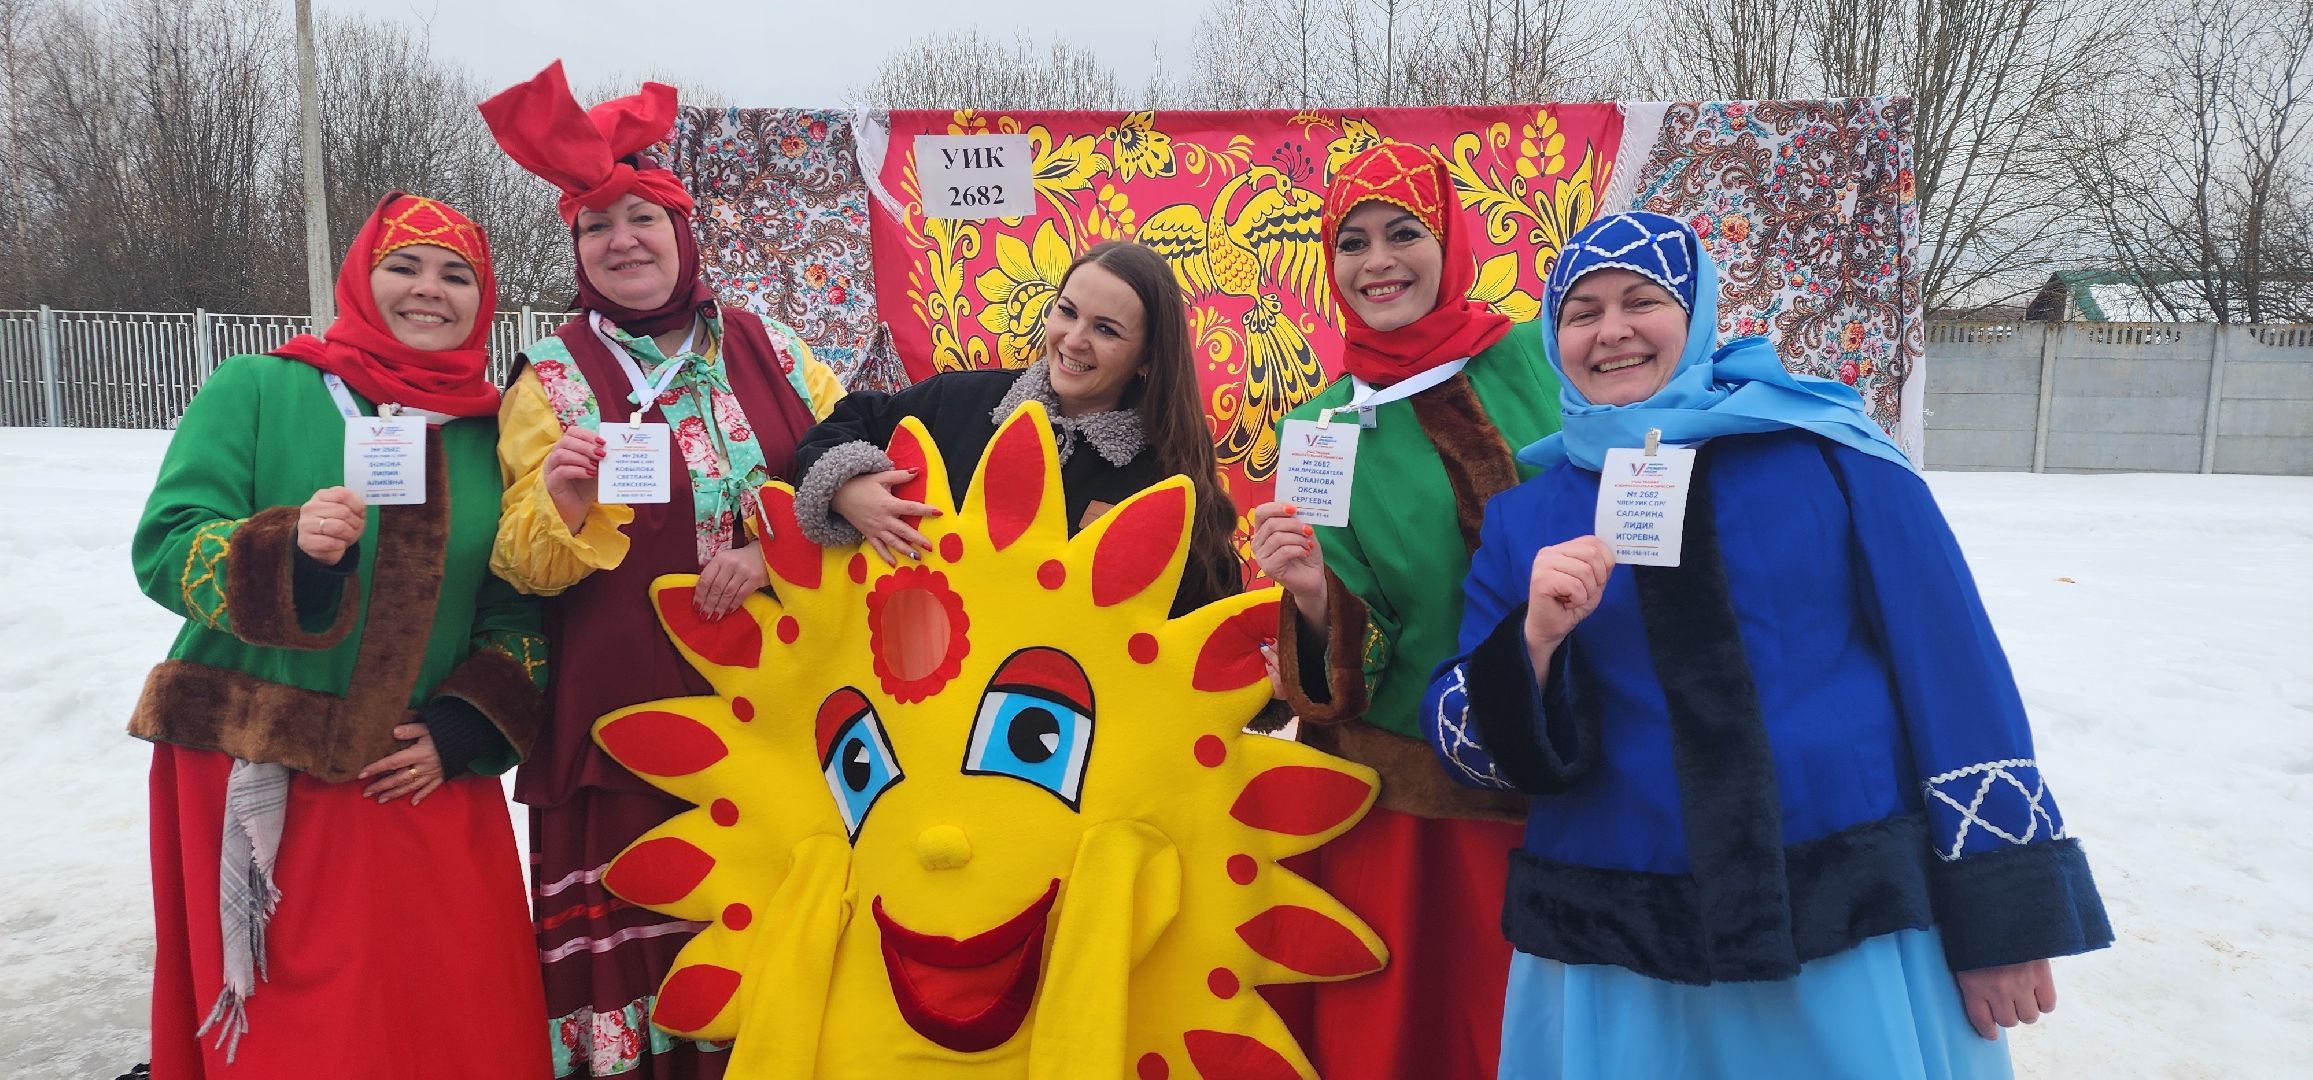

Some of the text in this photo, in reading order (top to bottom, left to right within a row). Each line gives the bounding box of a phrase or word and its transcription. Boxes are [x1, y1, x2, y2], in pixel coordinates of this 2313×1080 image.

[940, 146, 1005, 170] УИК
[948, 185, 1005, 207] 2682
[1293, 476, 1335, 486] ЛОБАНОВА
[1297, 486, 1328, 495] ОКСАНА
[1291, 496, 1333, 505] СЕРГЕЕВНА
[1616, 510, 1664, 519] САПАРИНА
[1623, 522, 1654, 530] ЛИДИЯ
[1616, 533, 1660, 542] ИГОРЕВНА
